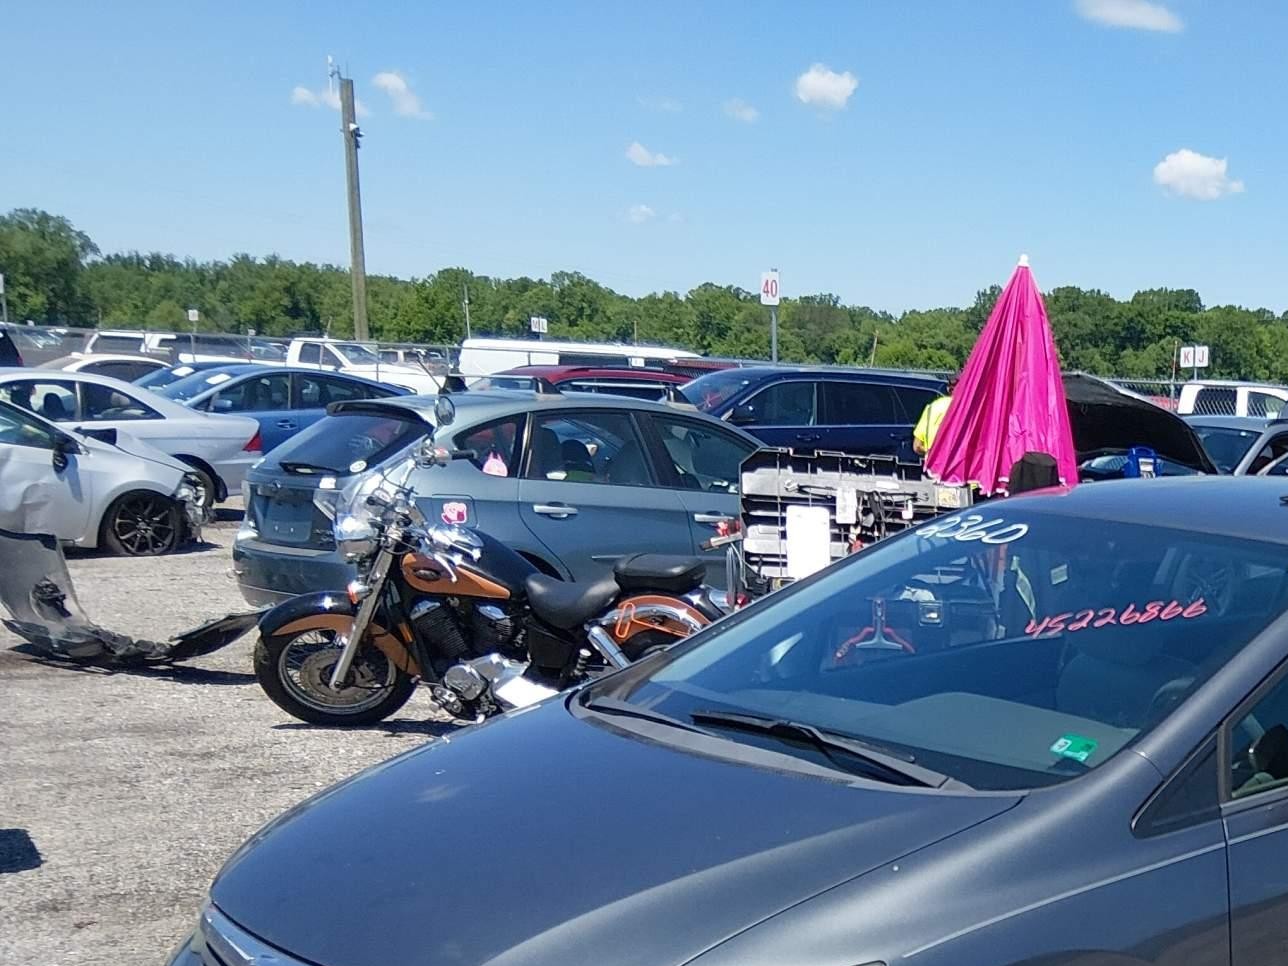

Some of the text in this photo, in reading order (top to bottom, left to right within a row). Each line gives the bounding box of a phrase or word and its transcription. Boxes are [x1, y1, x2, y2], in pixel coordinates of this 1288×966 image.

[763, 279, 778, 298] 40
[1183, 350, 1205, 364] K J
[1024, 597, 1207, 639] 45226866
